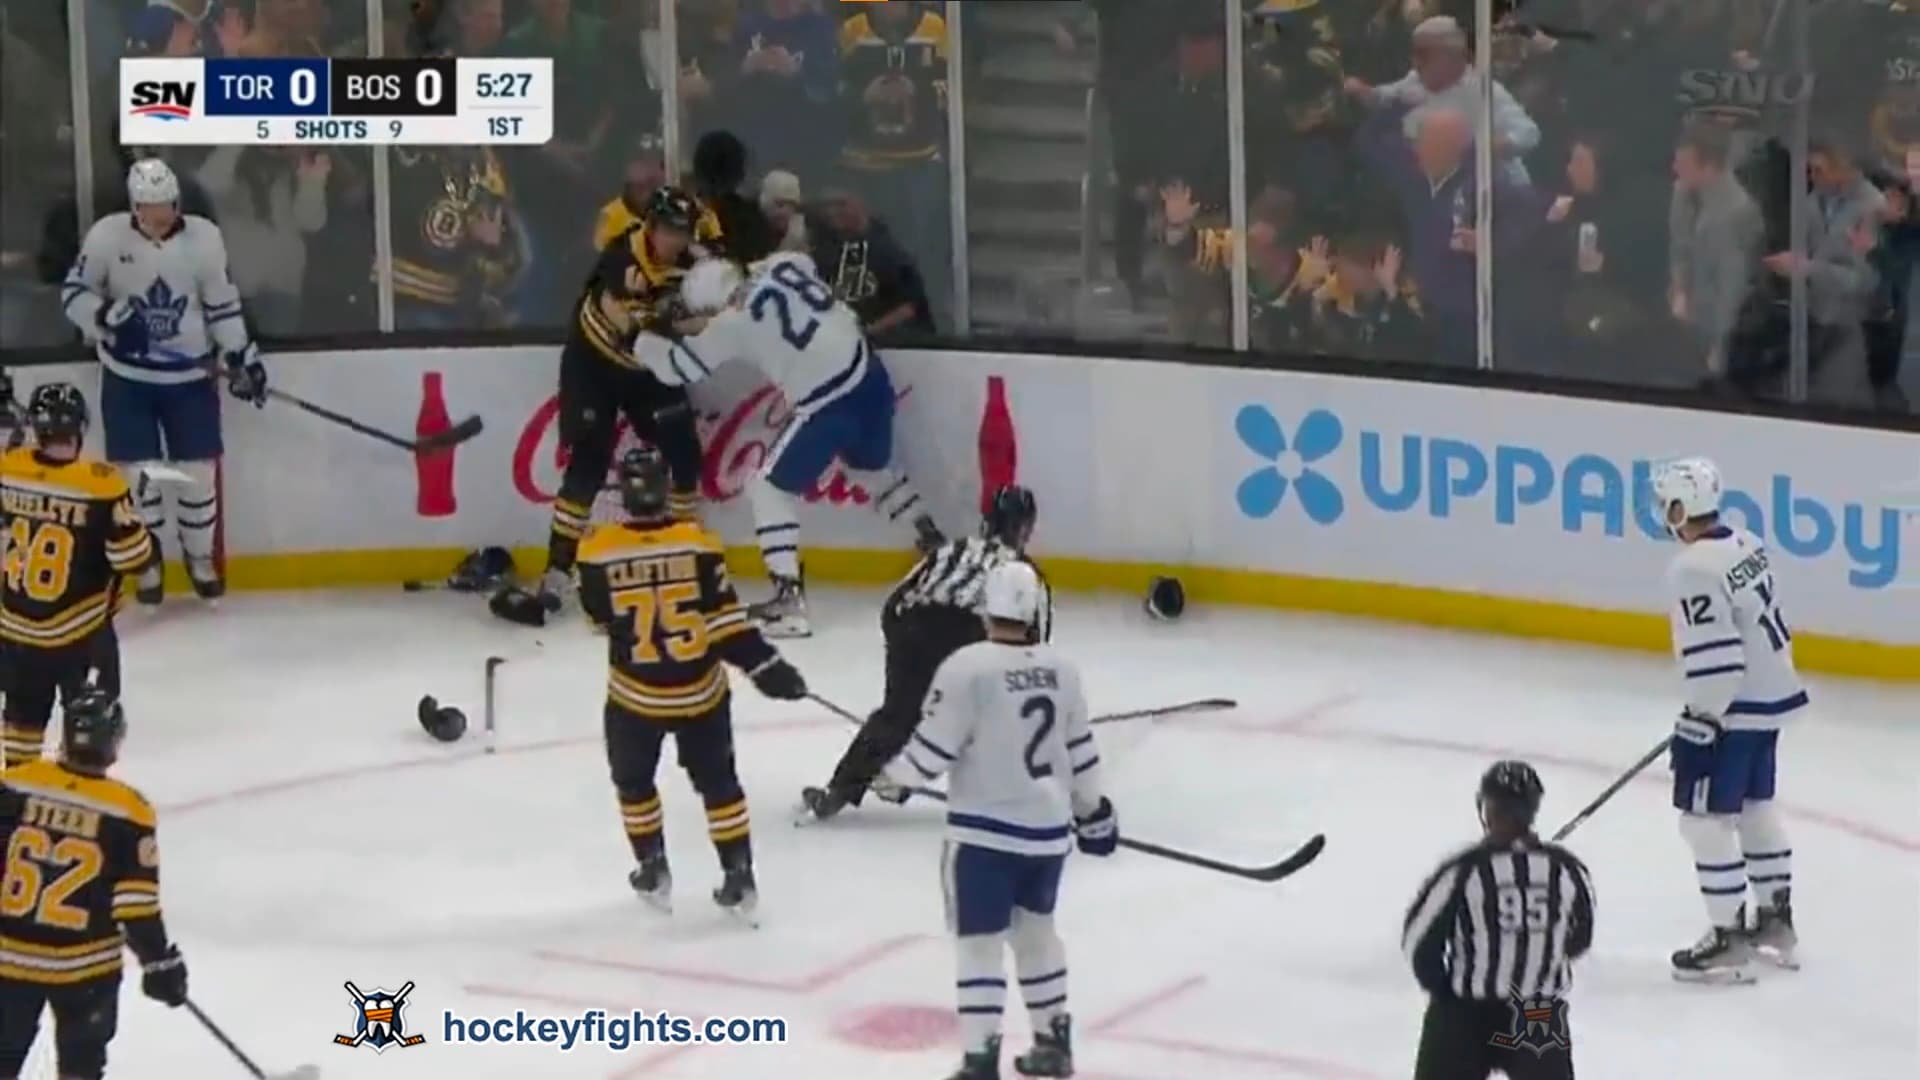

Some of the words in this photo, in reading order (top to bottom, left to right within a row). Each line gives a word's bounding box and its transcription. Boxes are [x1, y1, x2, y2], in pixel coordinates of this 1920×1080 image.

[751, 261, 834, 351] 28
[610, 580, 709, 664] 75
[1680, 594, 1715, 627] 12
[1020, 694, 1056, 780] 2
[0, 826, 104, 931] 62
[1497, 886, 1550, 933] 95
